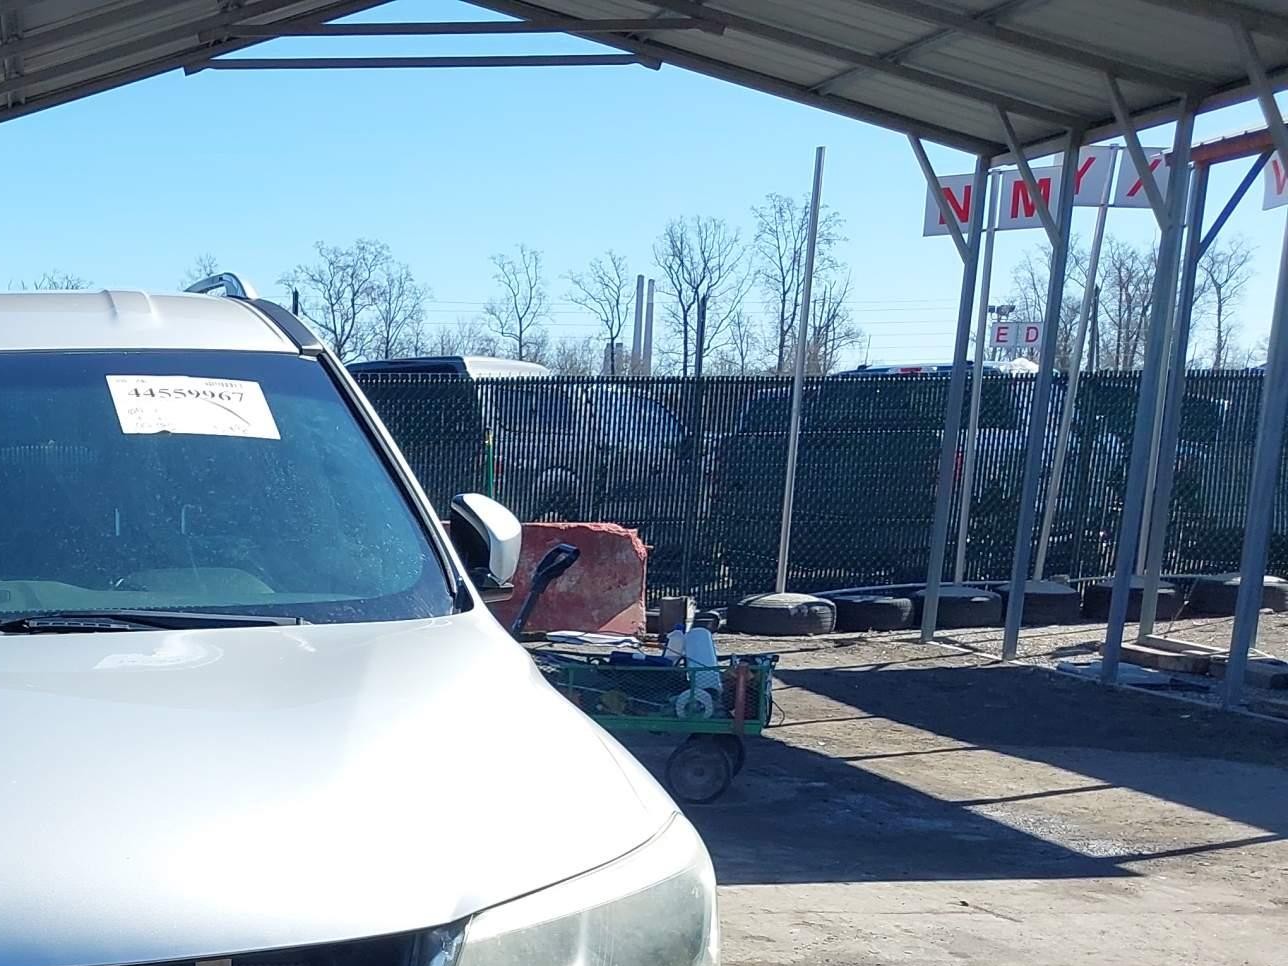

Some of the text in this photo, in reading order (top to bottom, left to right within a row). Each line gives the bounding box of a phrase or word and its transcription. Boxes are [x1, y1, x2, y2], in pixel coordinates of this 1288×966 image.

[939, 185, 972, 225] N
[1011, 177, 1051, 219] M
[995, 326, 1010, 343] E
[1025, 326, 1039, 343] D
[127, 387, 245, 403] 44559967
